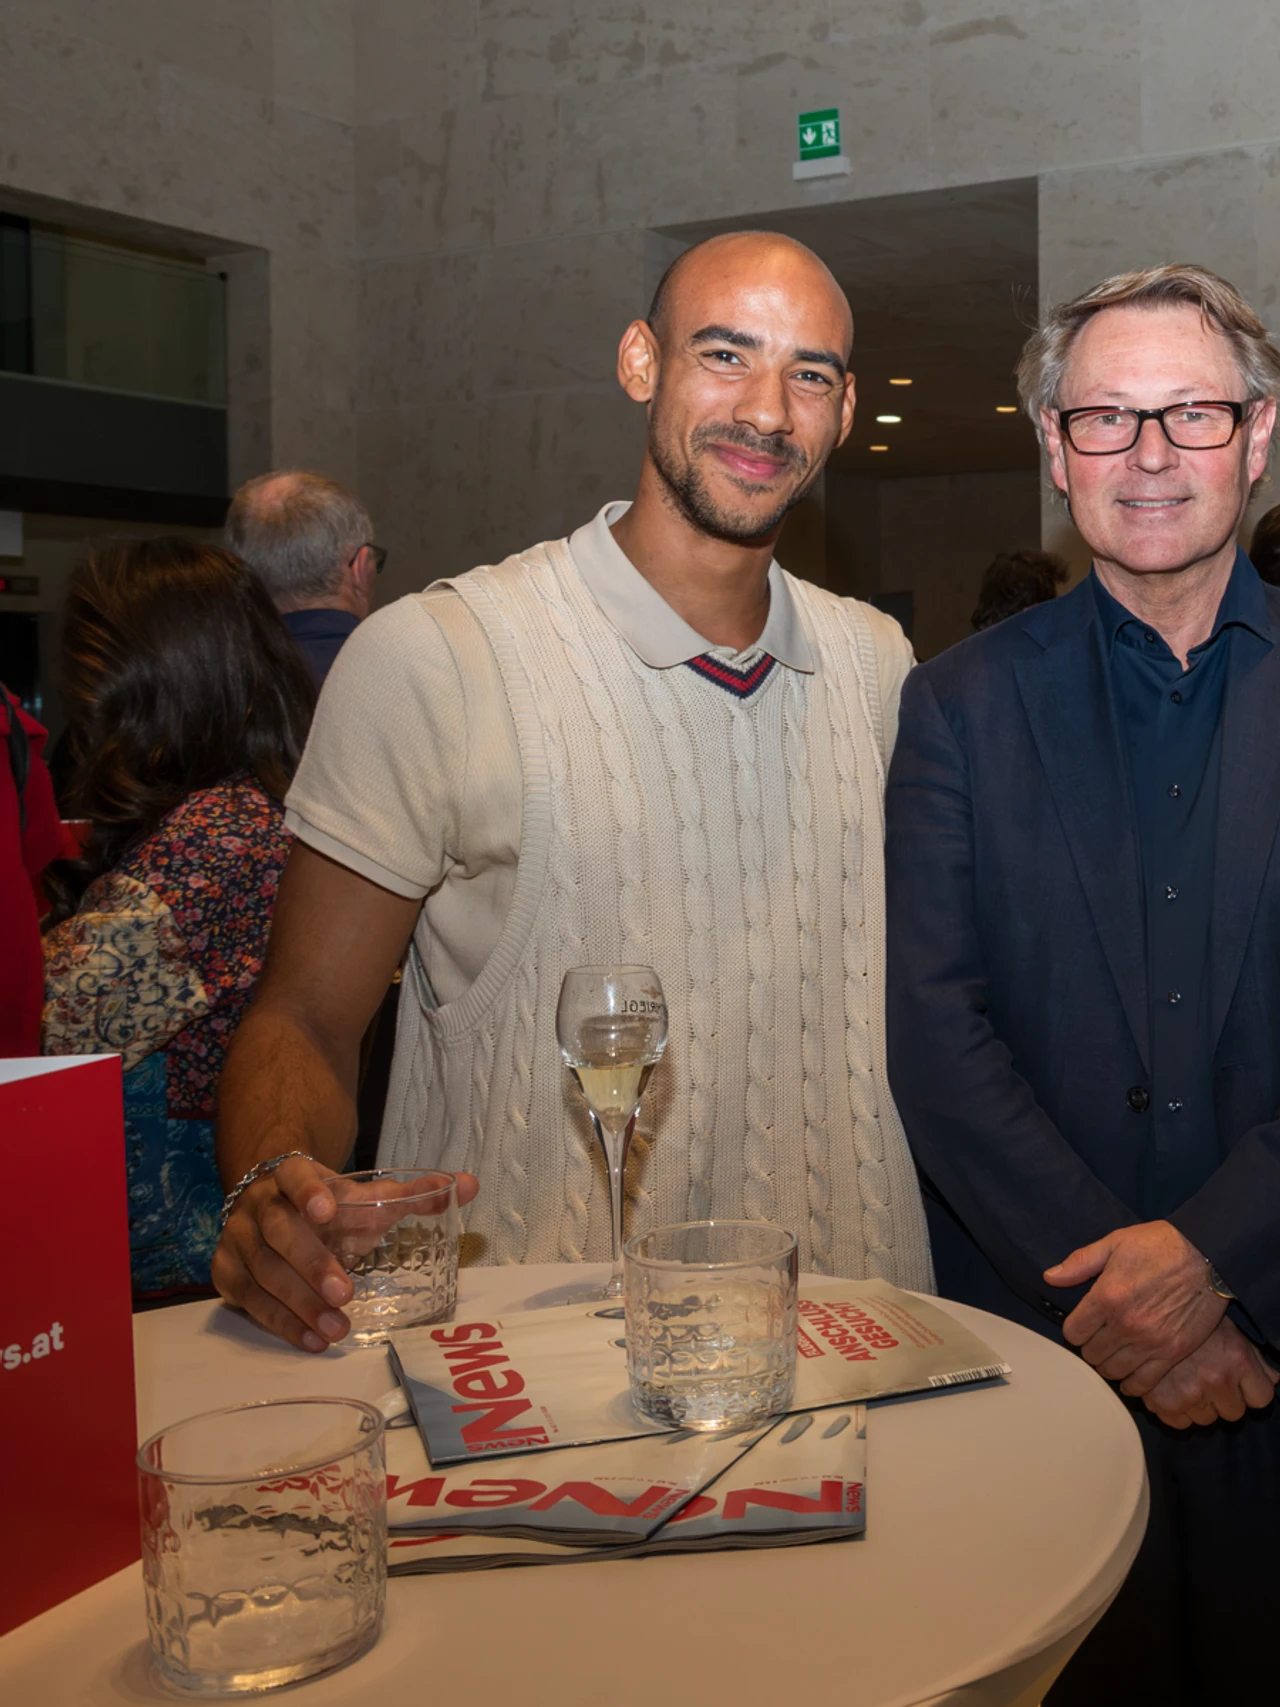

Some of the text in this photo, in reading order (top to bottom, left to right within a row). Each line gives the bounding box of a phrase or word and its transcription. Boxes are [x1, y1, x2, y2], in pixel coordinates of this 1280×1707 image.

[823, 1302, 899, 1349] GESUCHT
[0, 1321, 64, 1371] s.at
[430, 1322, 546, 1444] News
[466, 1435, 550, 1452] News
[642, 1488, 691, 1520] News
[846, 1481, 863, 1513] News
